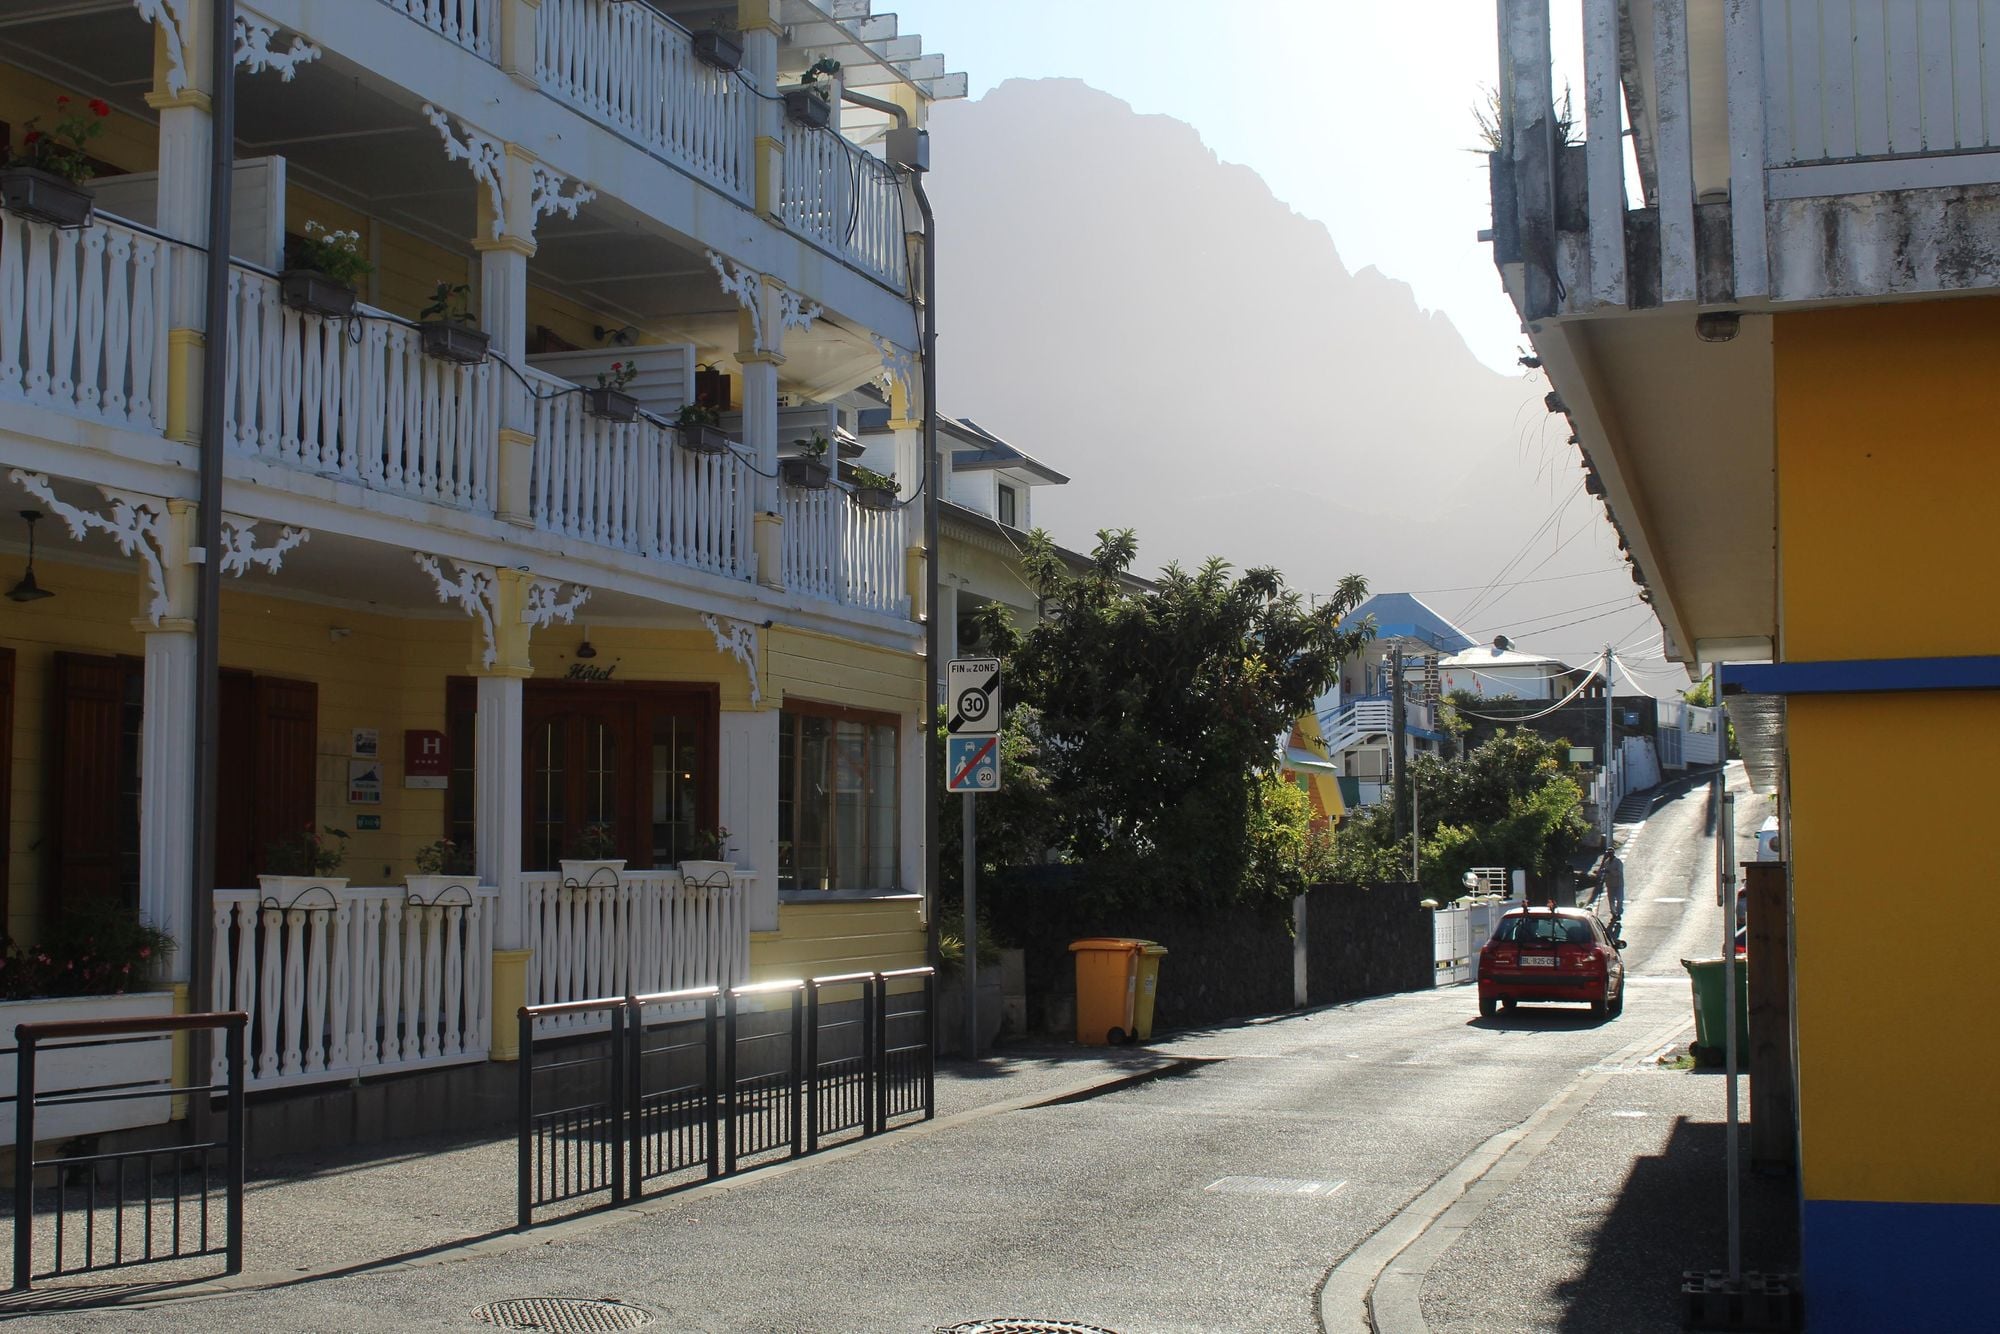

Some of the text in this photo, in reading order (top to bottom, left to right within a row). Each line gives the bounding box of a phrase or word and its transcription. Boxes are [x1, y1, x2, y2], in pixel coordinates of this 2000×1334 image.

[566, 664, 615, 680] Hôtel
[952, 665, 965, 673] FIN
[973, 664, 995, 672] ZONE
[964, 697, 983, 712] 30
[423, 737, 440, 754] H
[981, 773, 992, 781] 20
